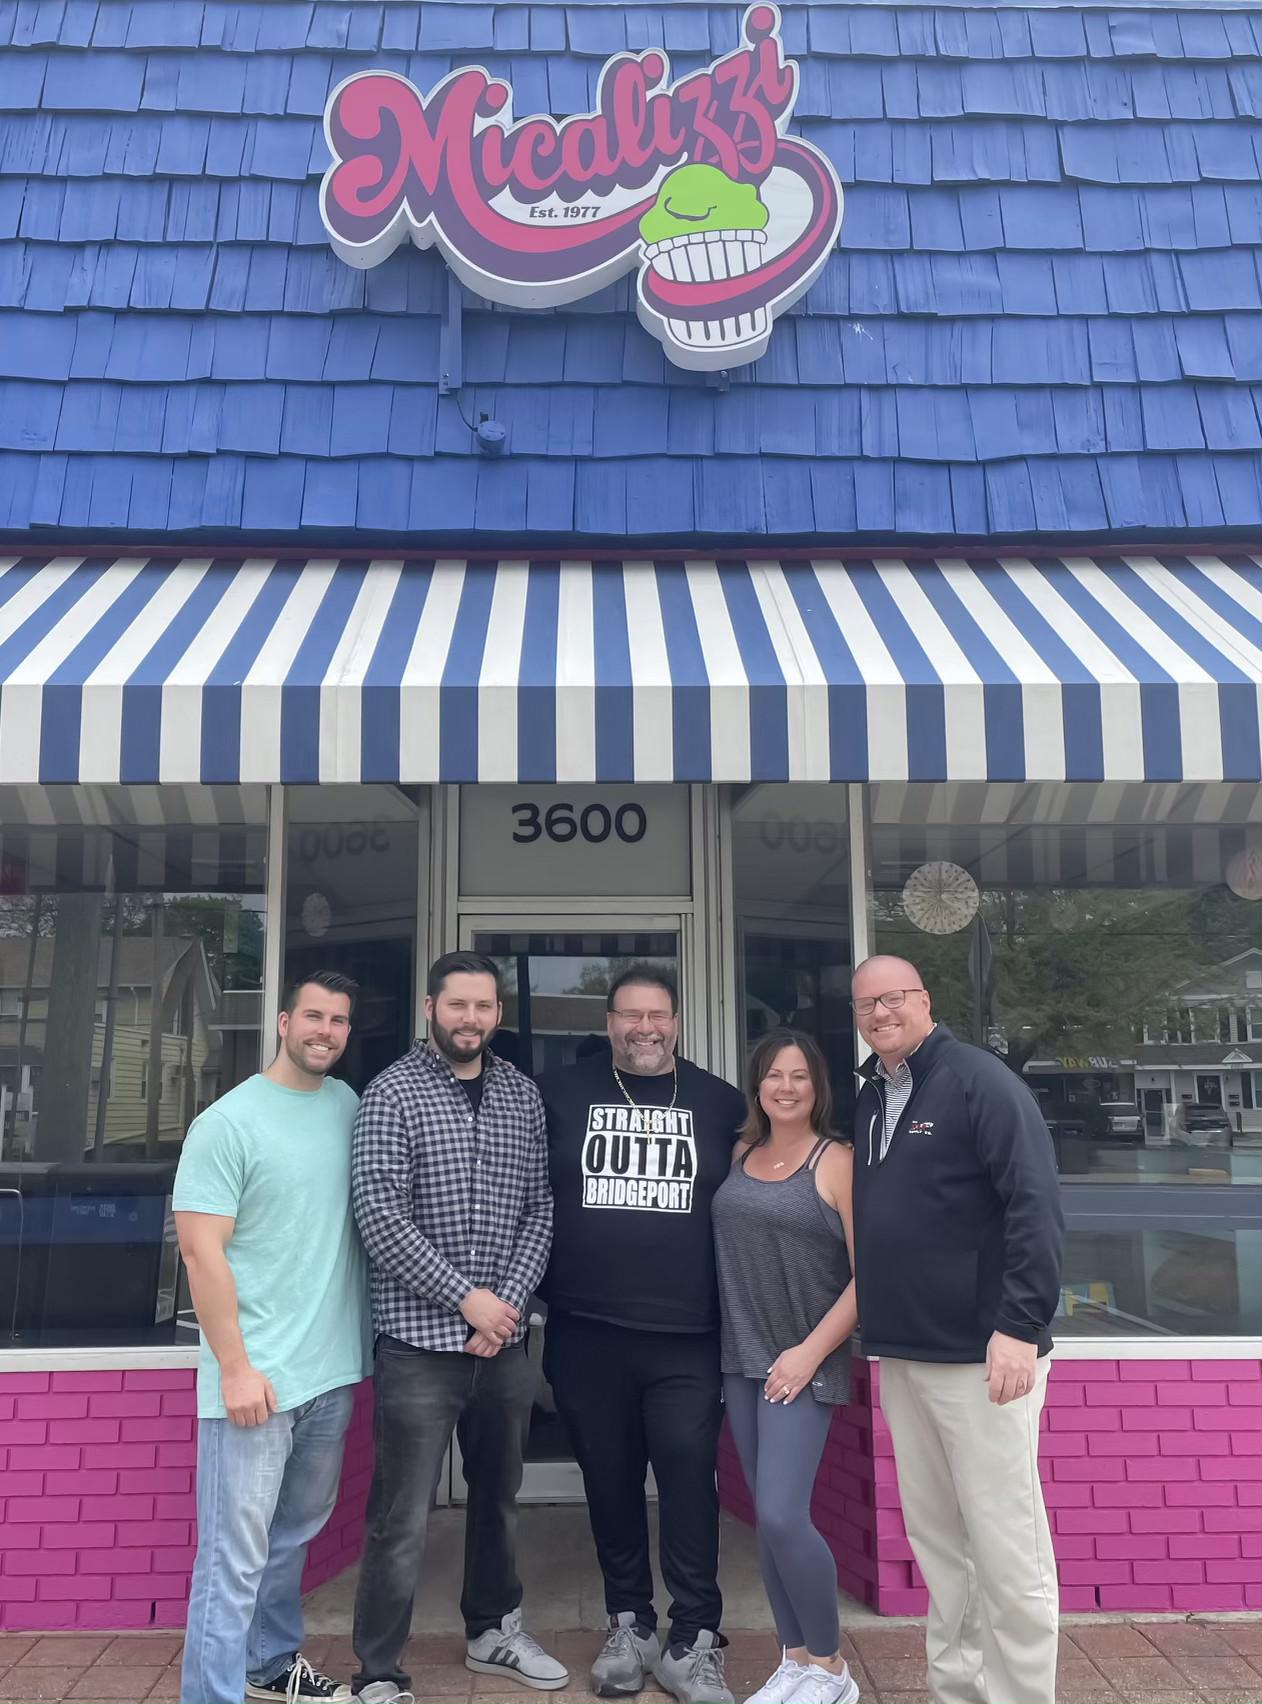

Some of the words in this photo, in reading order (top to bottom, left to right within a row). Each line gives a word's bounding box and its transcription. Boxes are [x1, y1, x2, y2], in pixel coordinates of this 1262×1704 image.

[325, 3, 800, 255] Micalizzi
[529, 206, 558, 218] Est.
[563, 206, 601, 218] 1977
[511, 802, 647, 843] 3600
[591, 1107, 689, 1136] STRAIGHT
[585, 1133, 693, 1179] OUTTA
[586, 1177, 690, 1209] BRIDGEPORT
